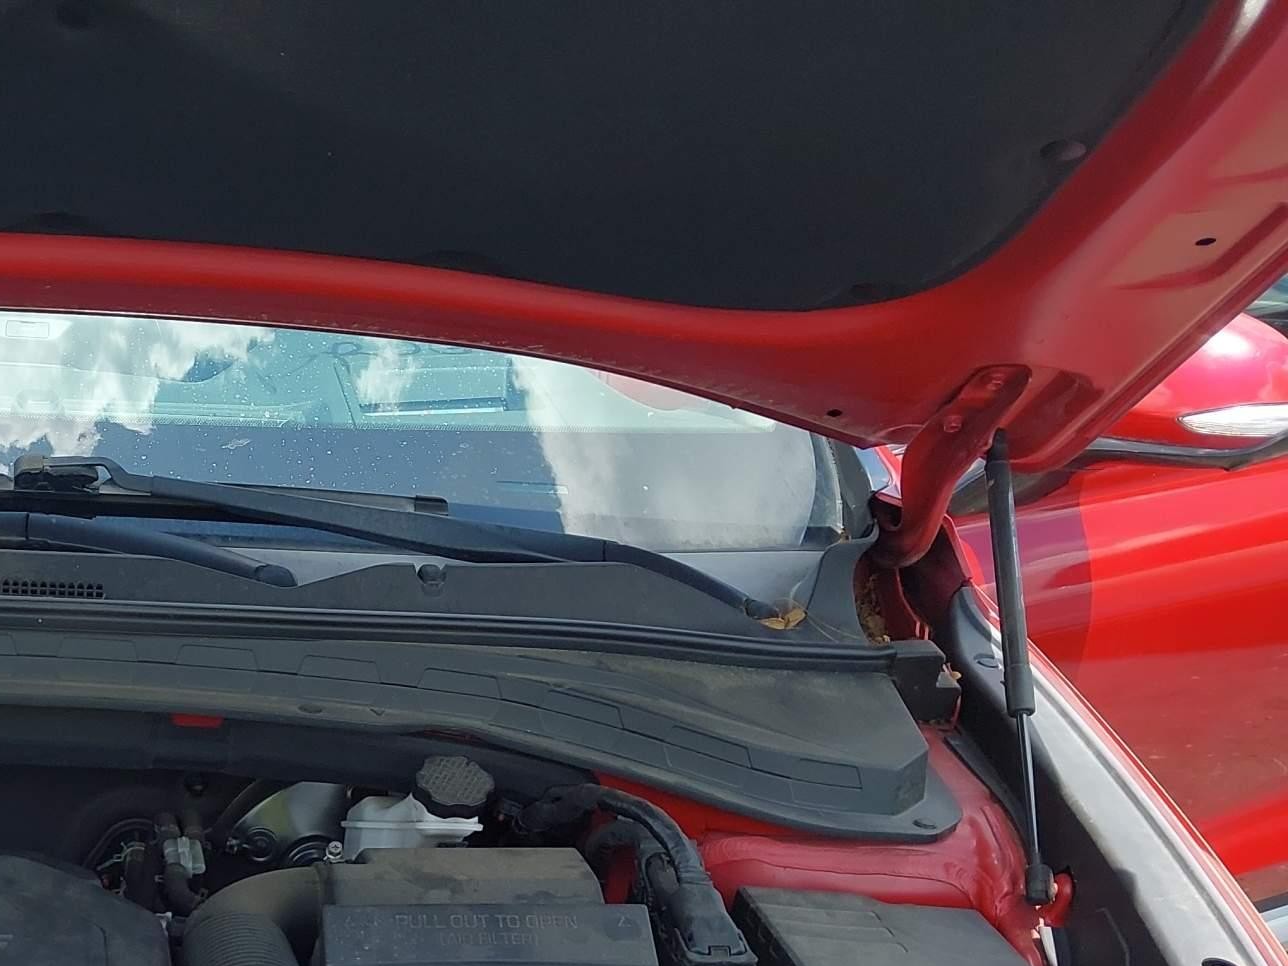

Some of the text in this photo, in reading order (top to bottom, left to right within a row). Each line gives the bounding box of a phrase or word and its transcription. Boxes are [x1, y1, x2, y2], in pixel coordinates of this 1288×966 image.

[394, 913, 579, 929] PULL OUT TO OPEN
